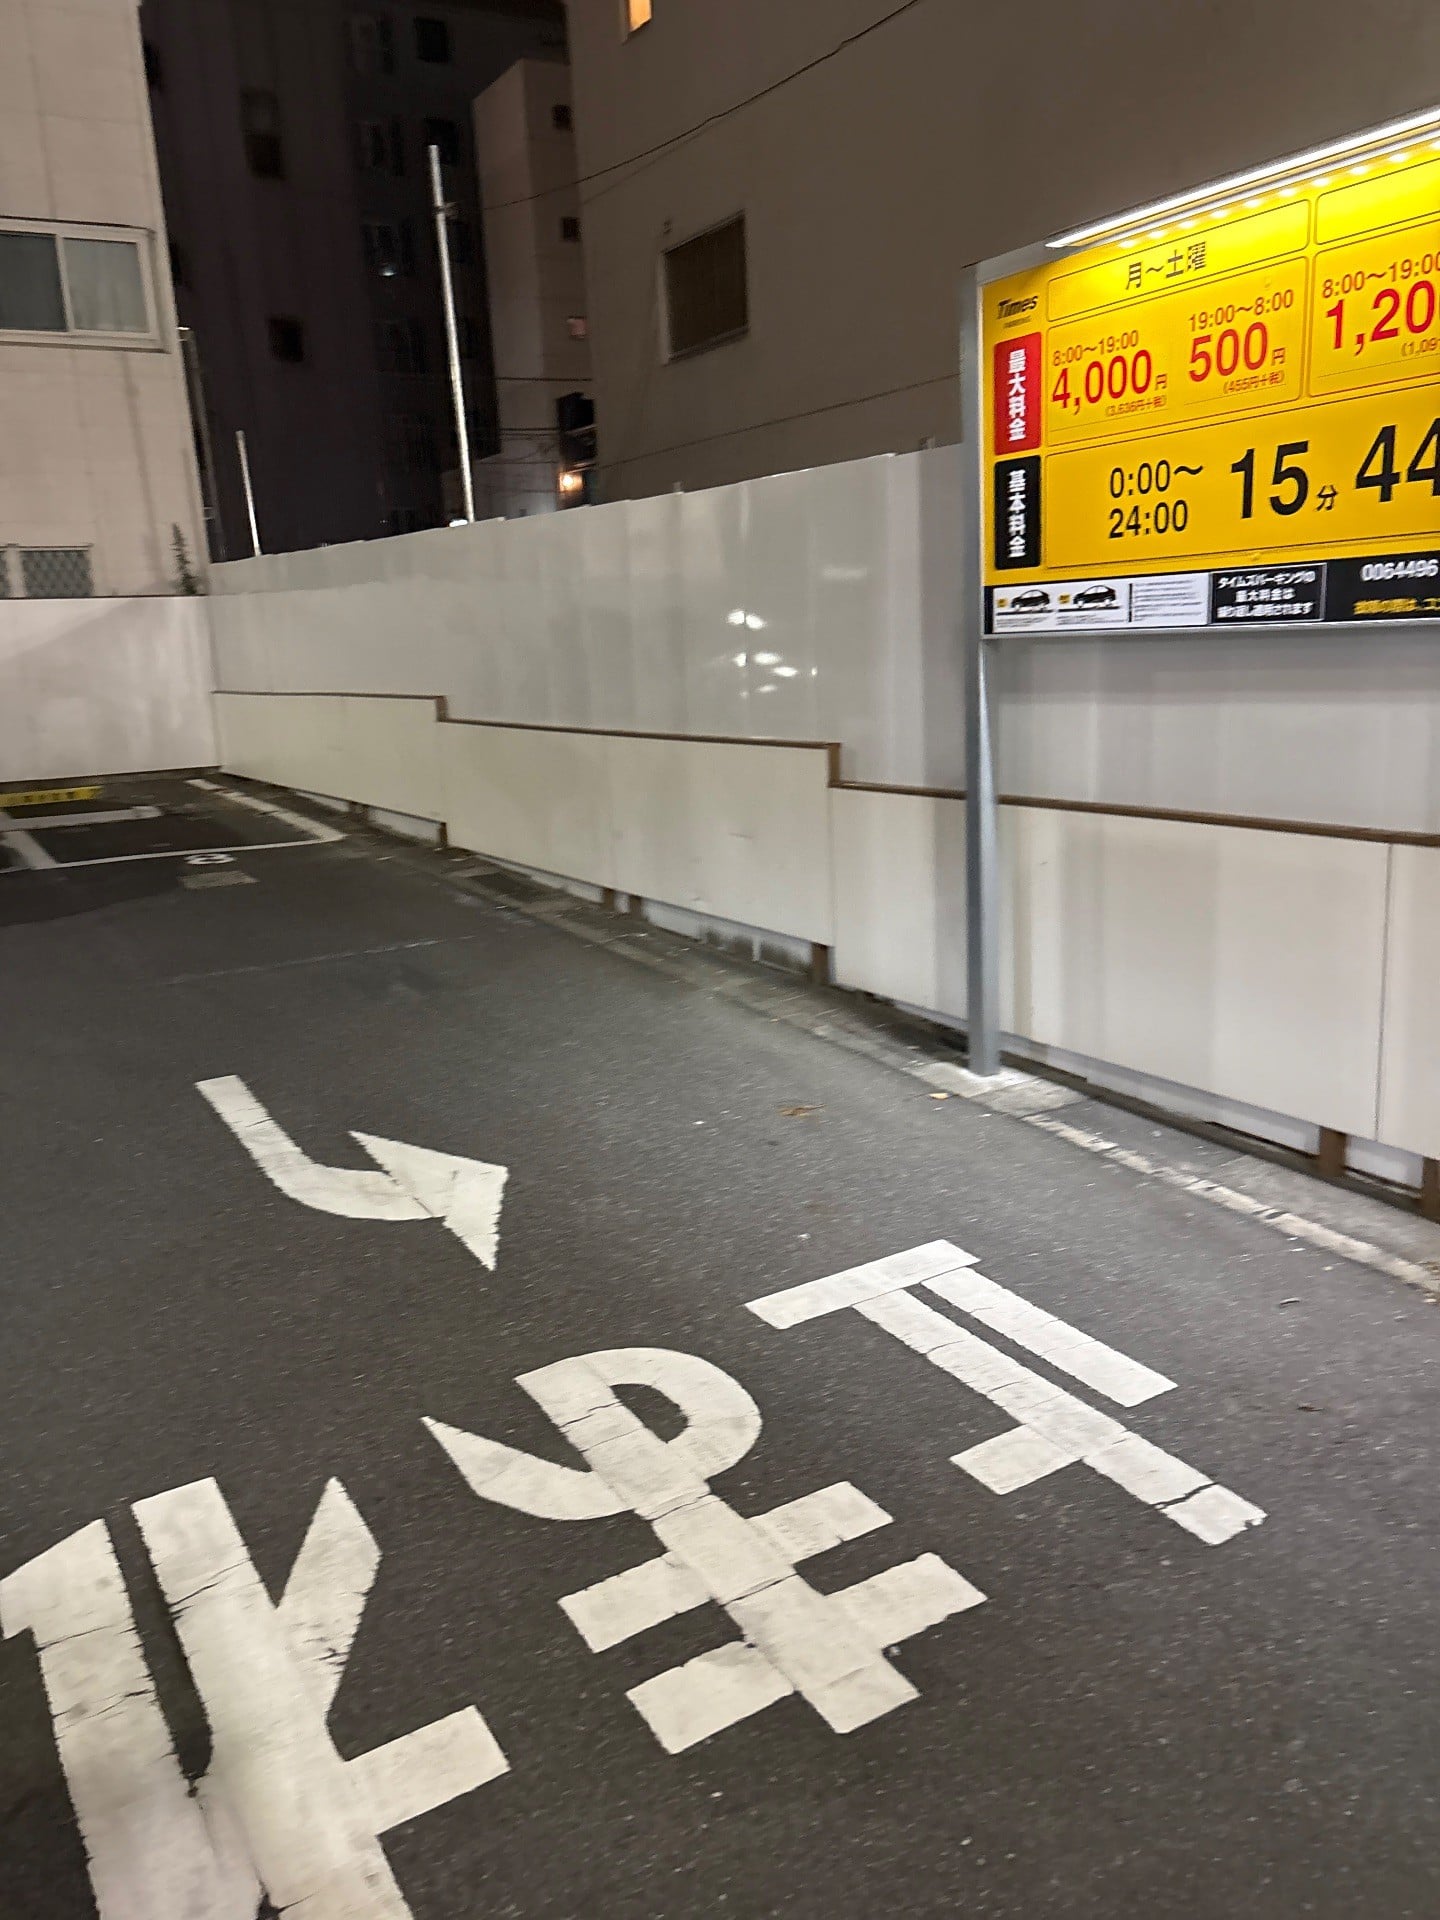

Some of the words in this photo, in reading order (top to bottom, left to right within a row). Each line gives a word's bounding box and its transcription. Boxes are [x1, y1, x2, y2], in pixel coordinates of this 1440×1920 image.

[997, 295, 1038, 320] Times
[1326, 280, 1440, 356] 1,20
[1008, 348, 1027, 442] 最大料金
[1008, 469, 1027, 559] 基本料金
[1109, 499, 1189, 539] 24:00
[1360, 559, 1439, 583] 0064496
